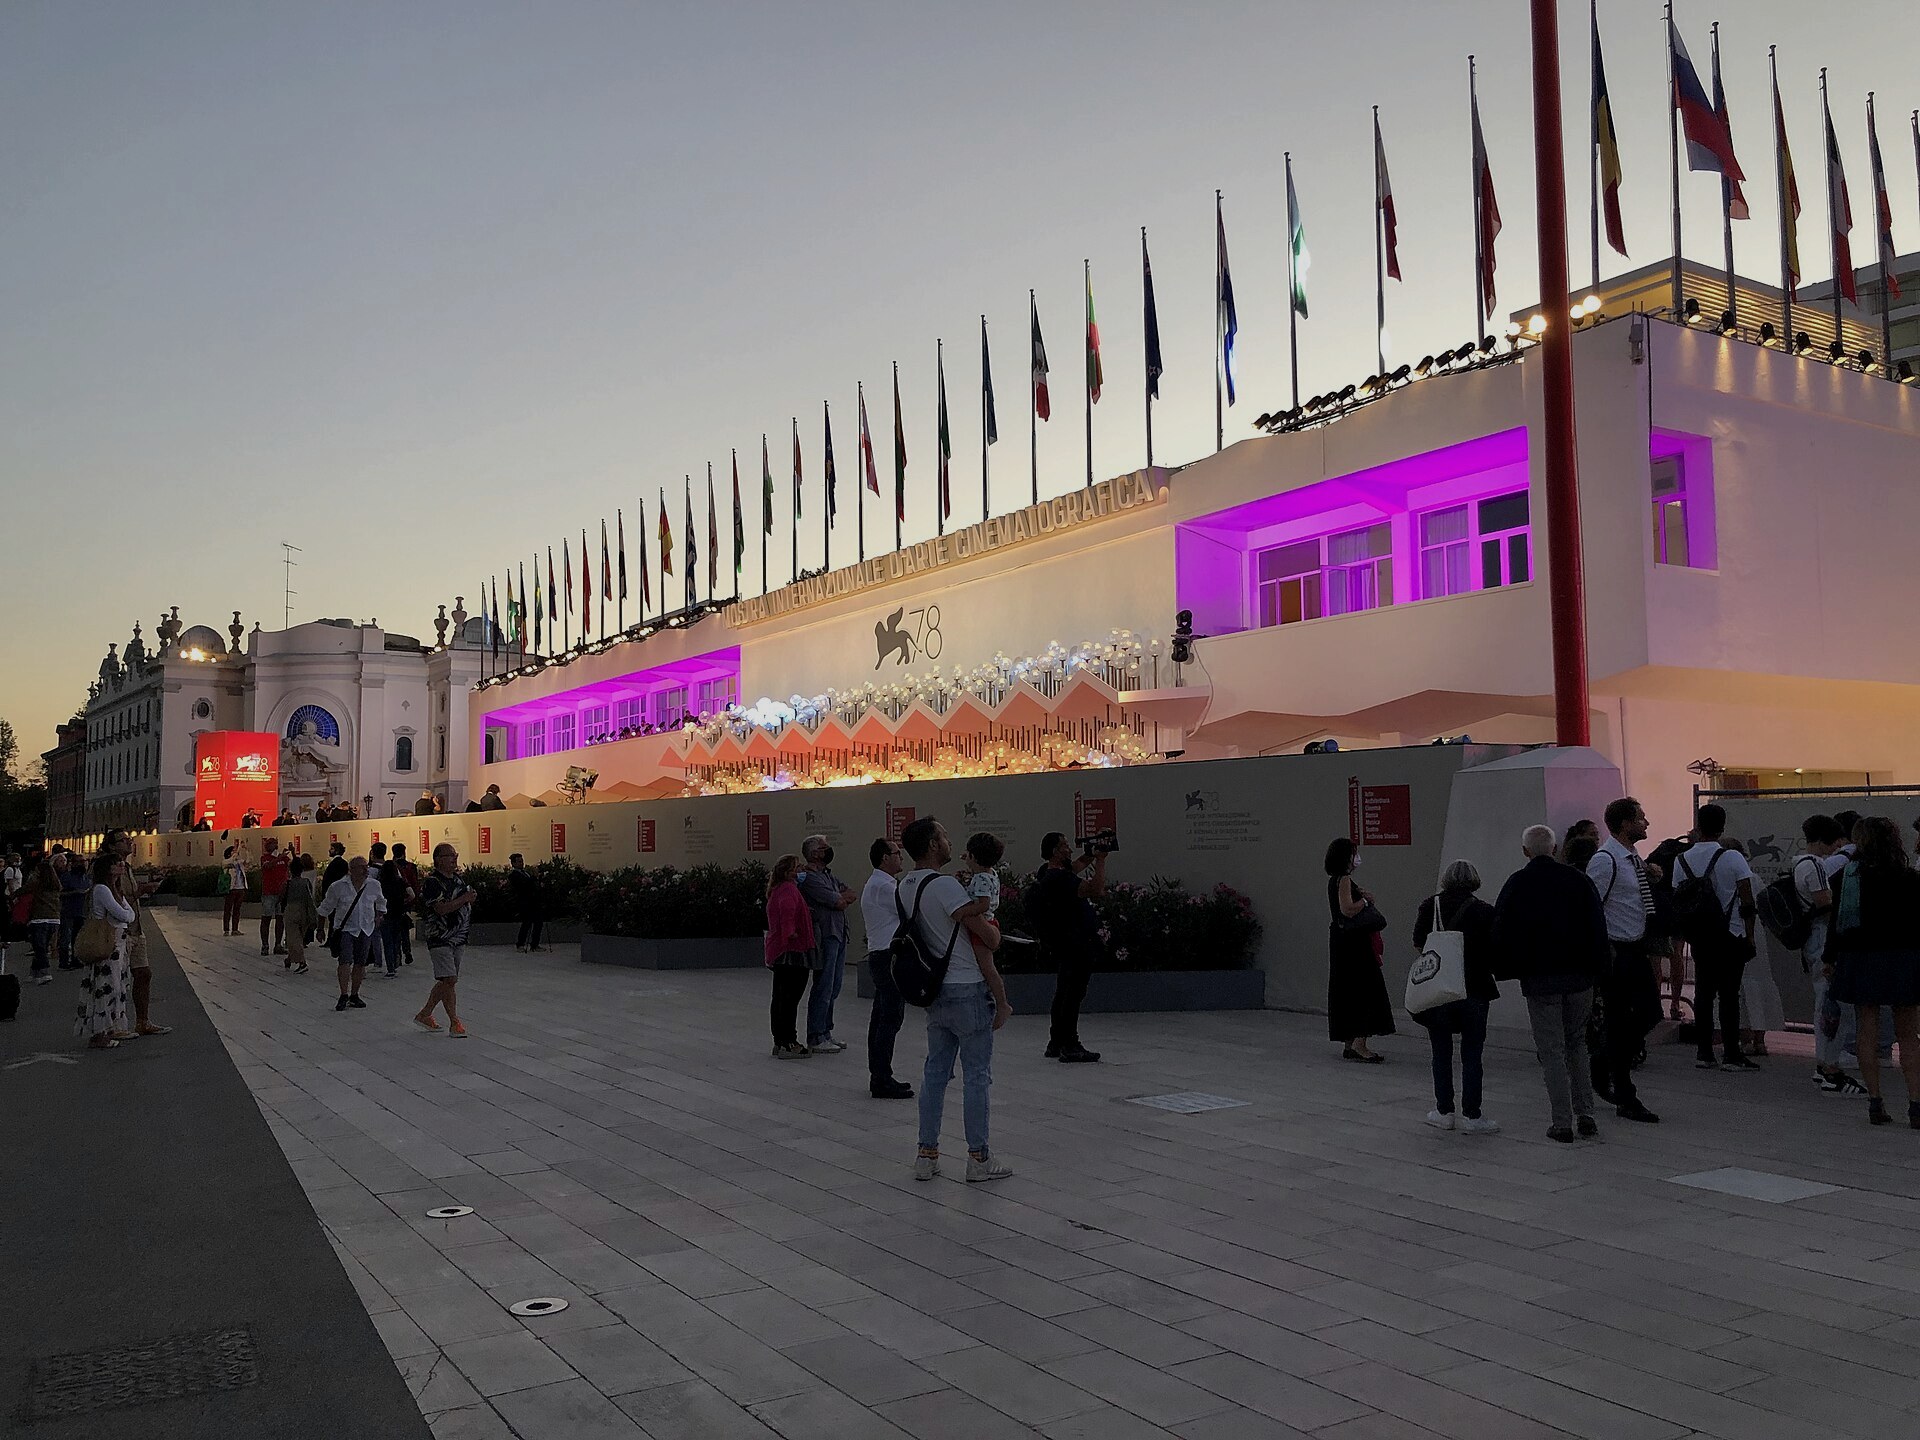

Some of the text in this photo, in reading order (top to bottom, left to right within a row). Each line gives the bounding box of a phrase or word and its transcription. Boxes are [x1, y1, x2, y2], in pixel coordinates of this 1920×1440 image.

[722, 469, 1154, 629] MOSTRA INTERNAZIONALE D'ARTE CINEMATOGRAFICA
[909, 605, 943, 664] 78
